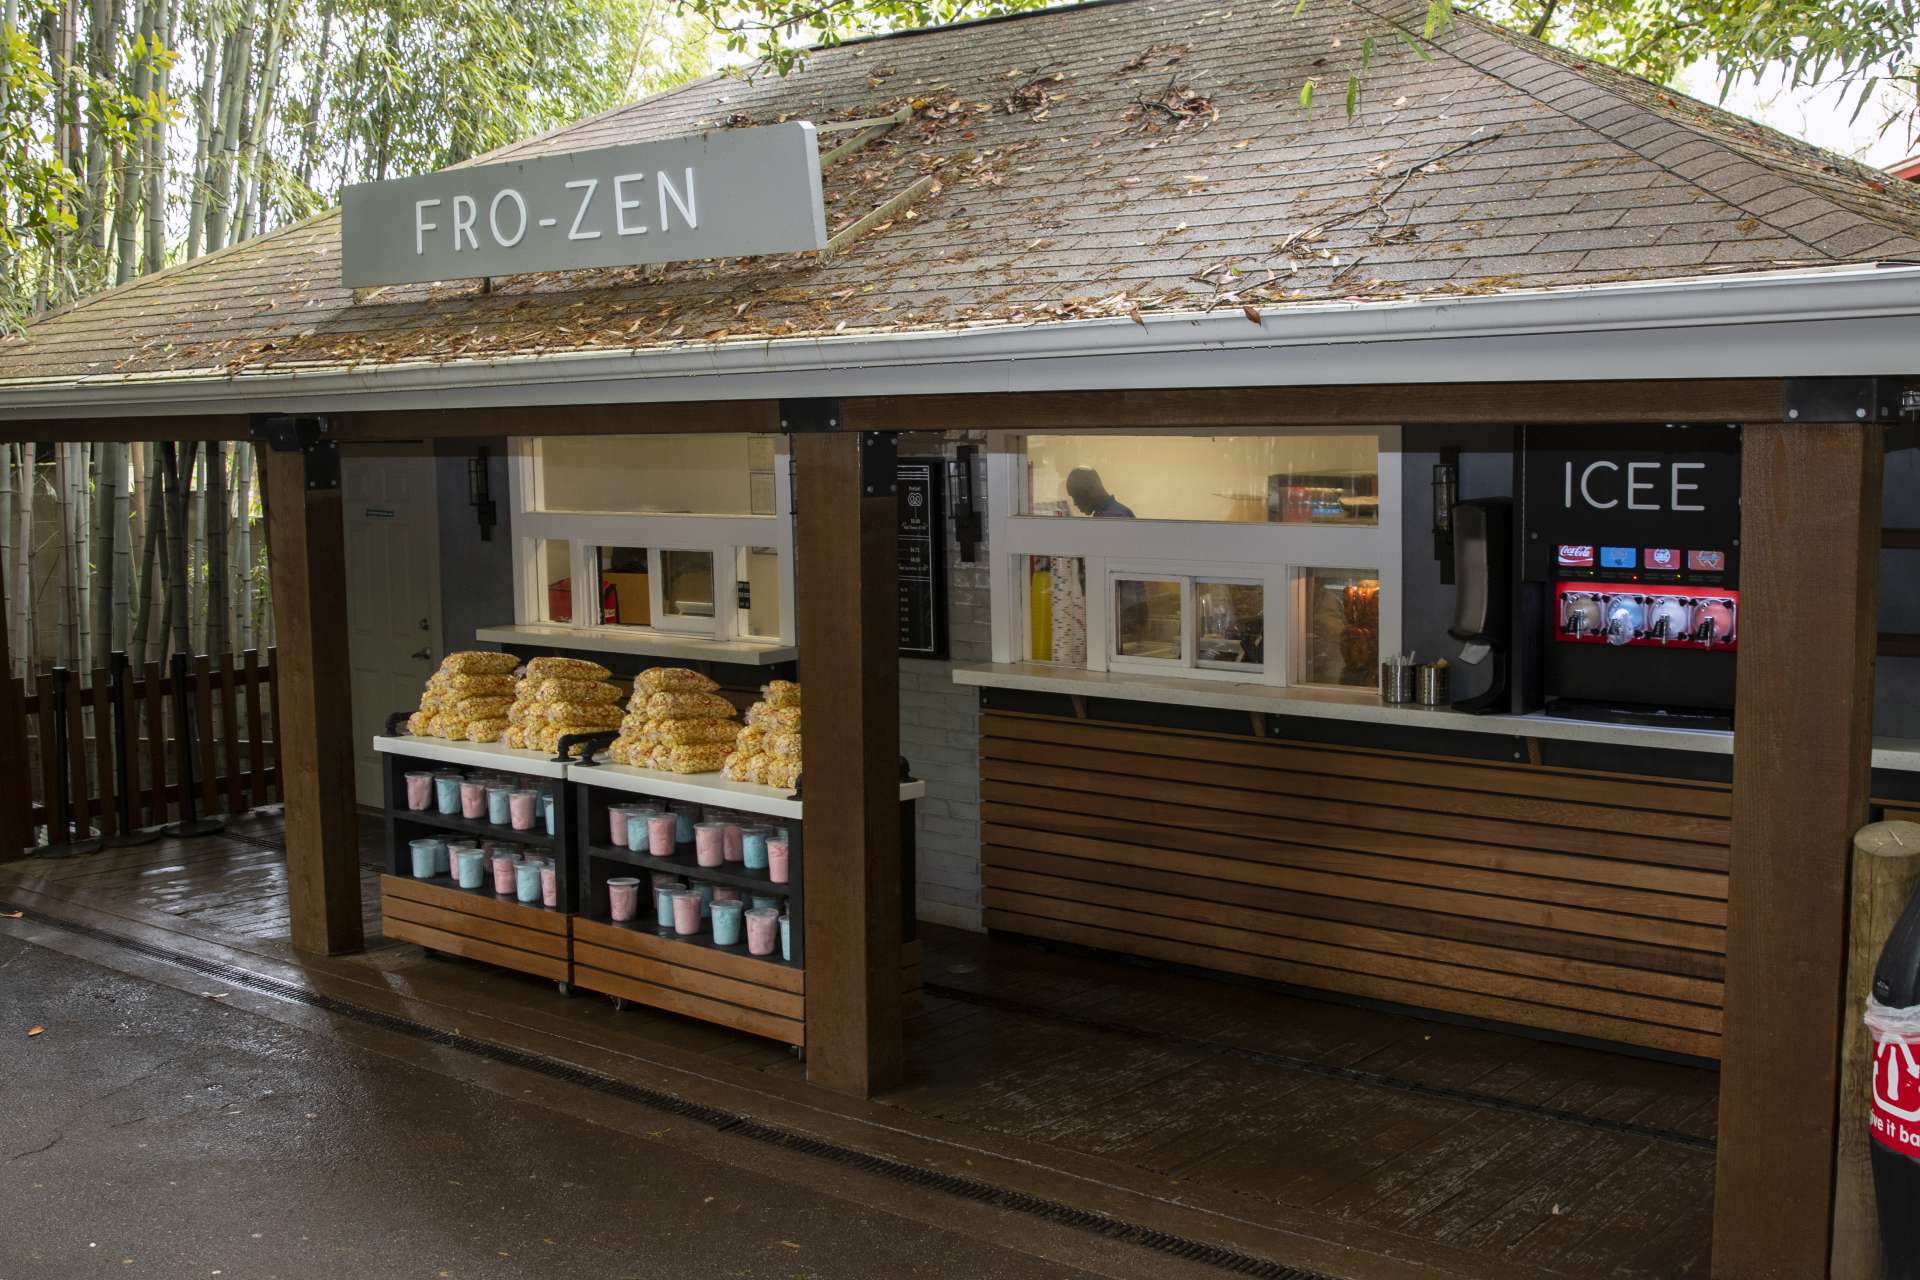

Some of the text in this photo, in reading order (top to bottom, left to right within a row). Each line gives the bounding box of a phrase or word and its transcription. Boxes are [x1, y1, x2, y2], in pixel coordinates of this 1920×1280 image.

[415, 166, 698, 255] FRO-ZEN
[1564, 460, 1705, 511] ICEE
[1886, 1118, 1896, 1138] it
[1900, 1124, 1920, 1147] ba
